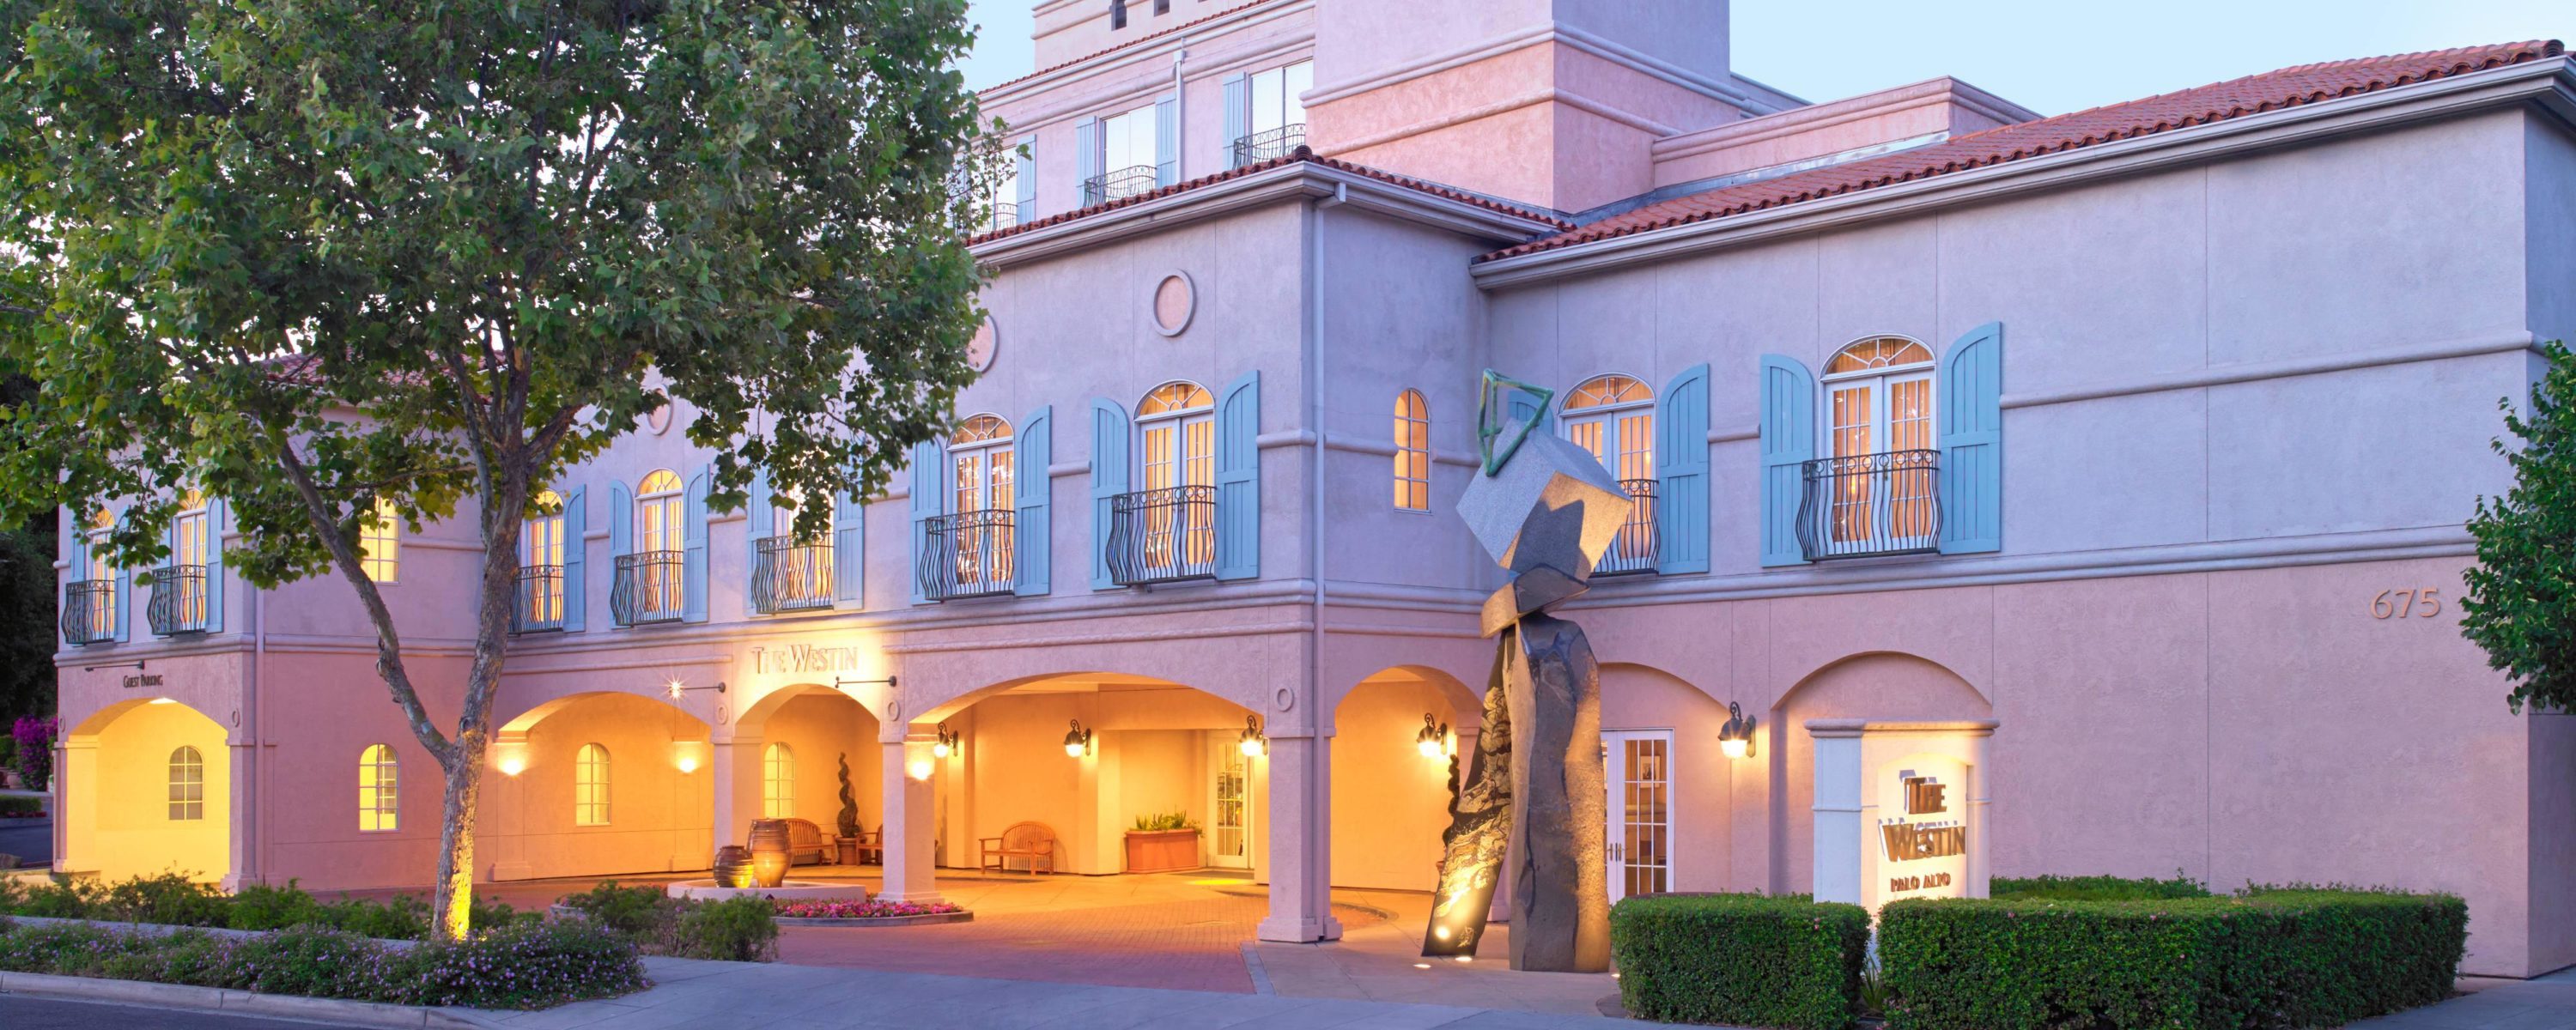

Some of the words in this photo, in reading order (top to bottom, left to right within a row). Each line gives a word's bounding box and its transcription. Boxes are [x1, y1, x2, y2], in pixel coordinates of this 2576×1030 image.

[2371, 587, 2441, 620] 675
[750, 646, 787, 674] THE
[787, 645, 858, 672] WESTIN
[1904, 777, 1947, 815] THE
[1881, 827, 1965, 863] WESTIN
[1891, 876, 1920, 892] PALO
[1923, 872, 1951, 888] ALTO
